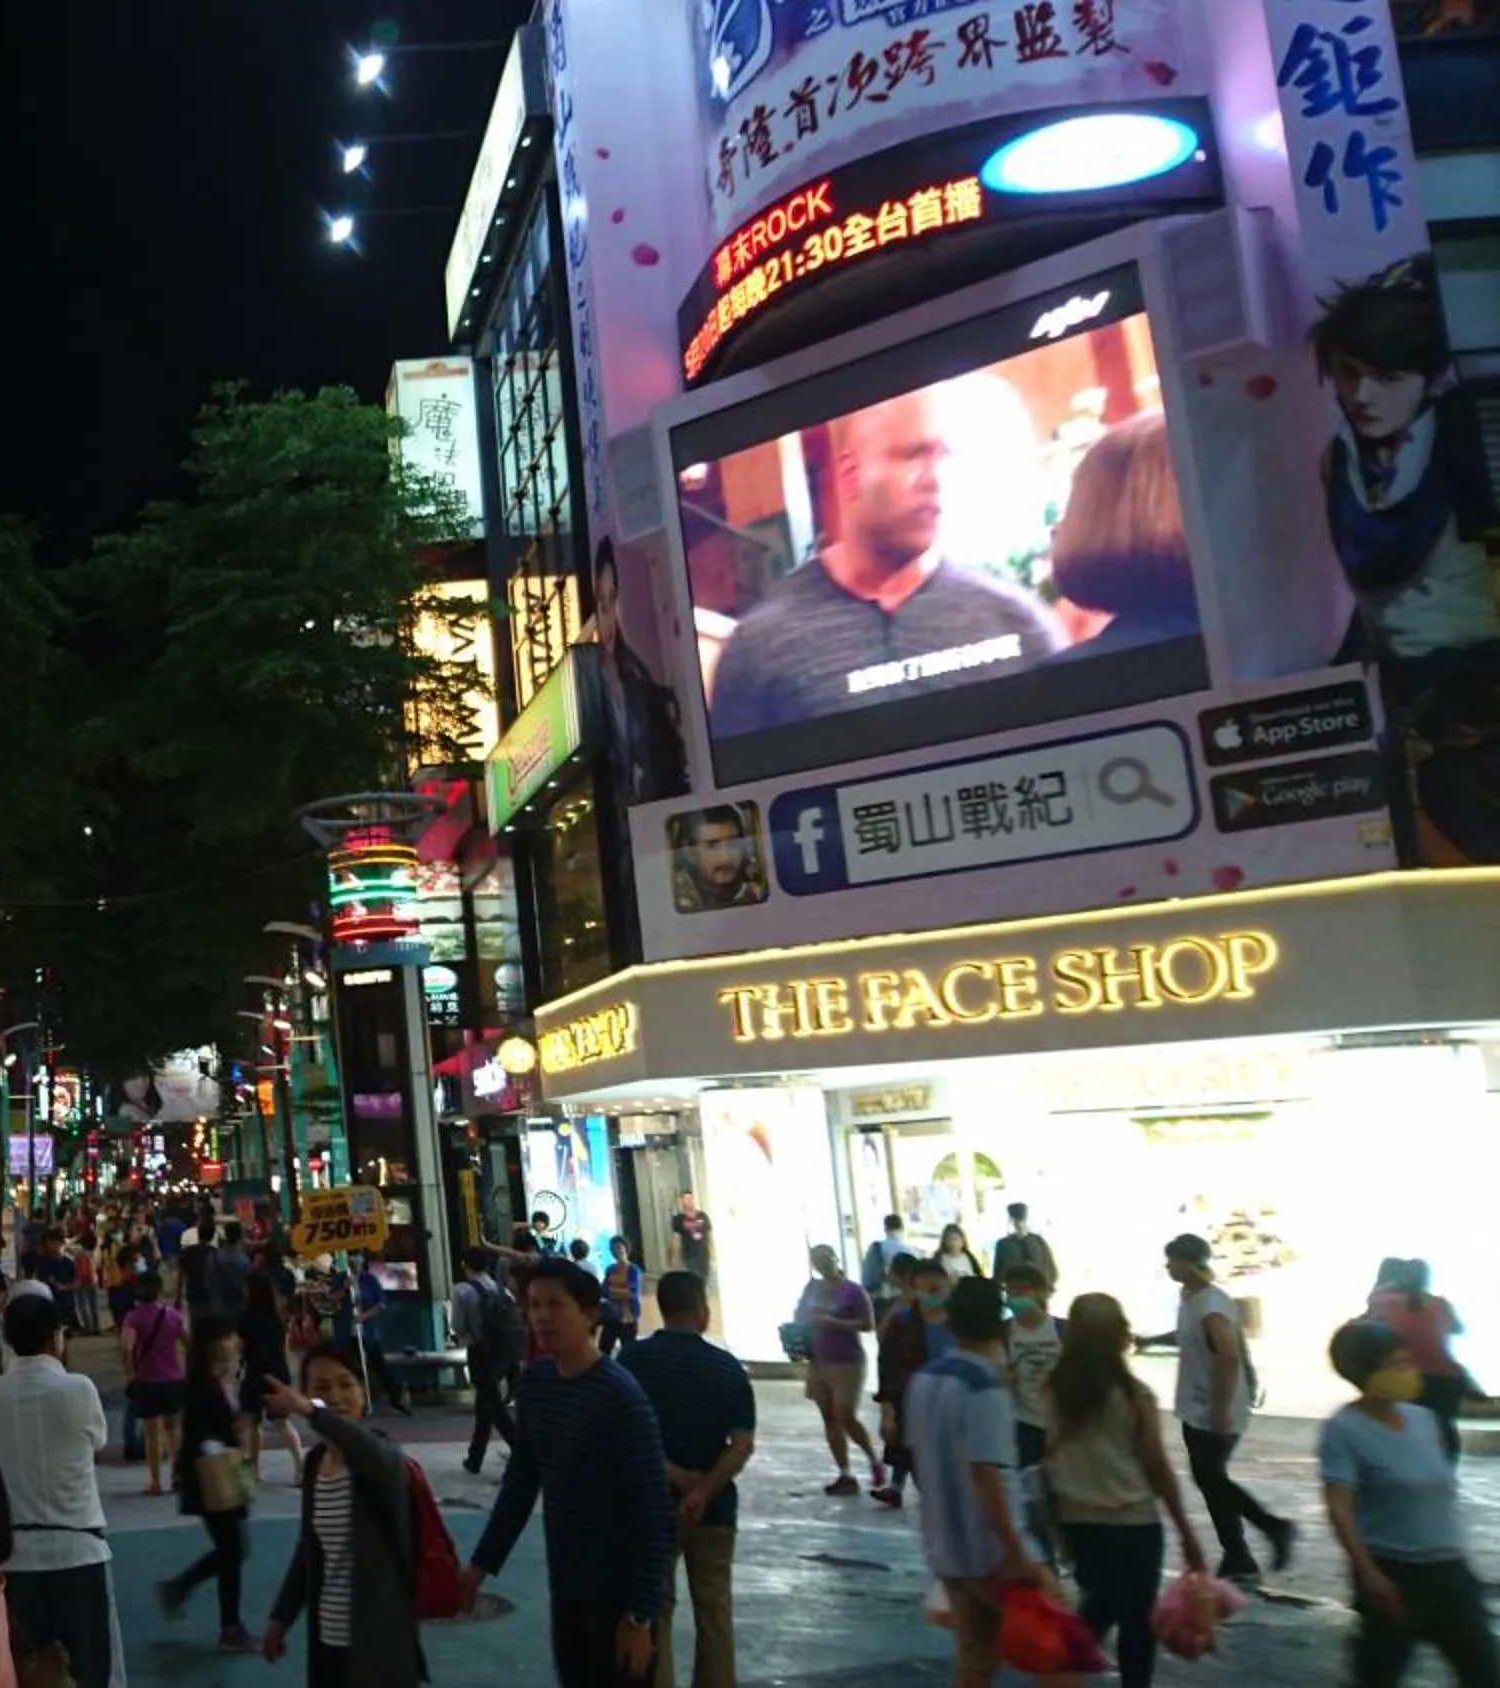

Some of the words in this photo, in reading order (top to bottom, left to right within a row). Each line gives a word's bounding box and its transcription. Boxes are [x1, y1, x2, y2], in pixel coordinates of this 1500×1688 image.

[1253, 724, 1297, 746] App
[1300, 712, 1360, 735] Store
[853, 770, 1074, 856] 蜀山戰紀
[1261, 782, 1329, 806] Google
[719, 978, 854, 1042] THE
[859, 955, 1043, 1031] FACE
[1052, 930, 1279, 1015] SHOP
